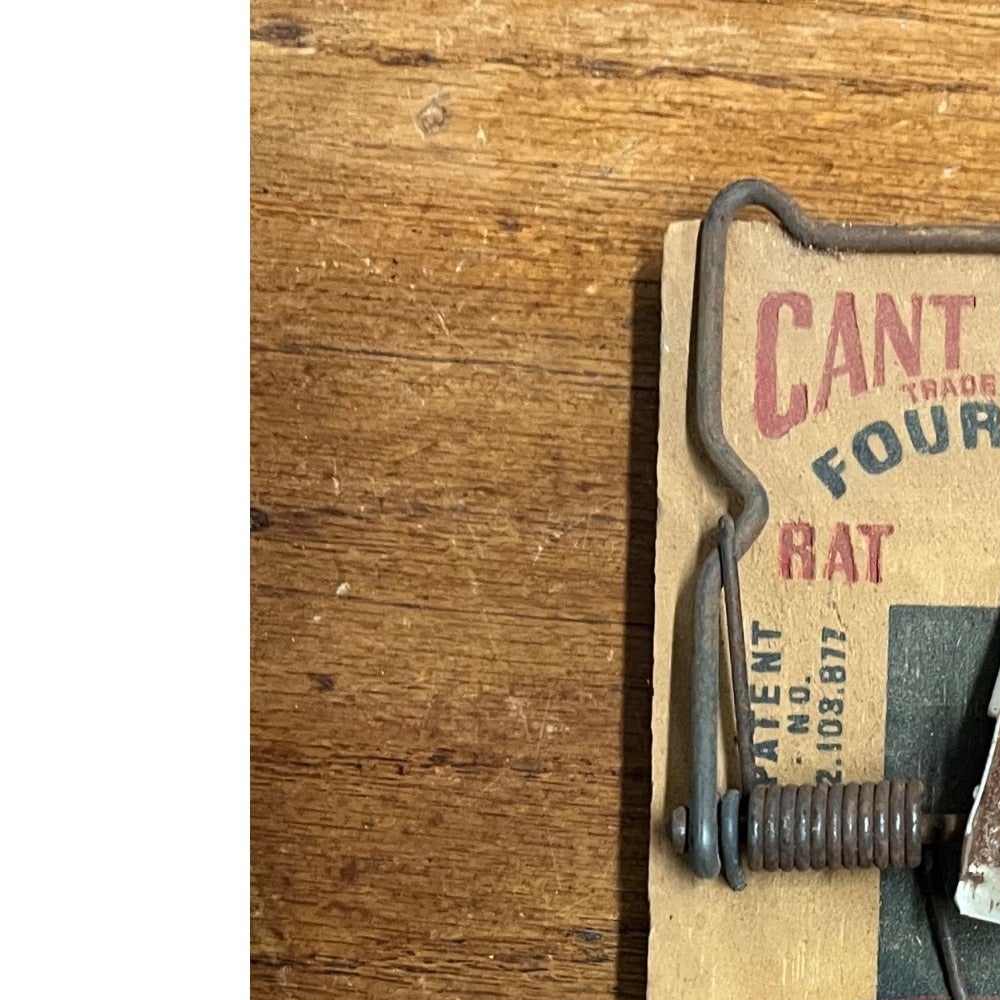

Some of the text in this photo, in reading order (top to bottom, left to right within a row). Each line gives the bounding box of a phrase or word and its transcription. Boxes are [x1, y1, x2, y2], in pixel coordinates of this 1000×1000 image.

[754, 291, 976, 438] CANT
[900, 374, 996, 401] TRADE
[778, 522, 894, 583] RAT
[750, 620, 782, 785] PATENT
[787, 676, 811, 735] NO.
